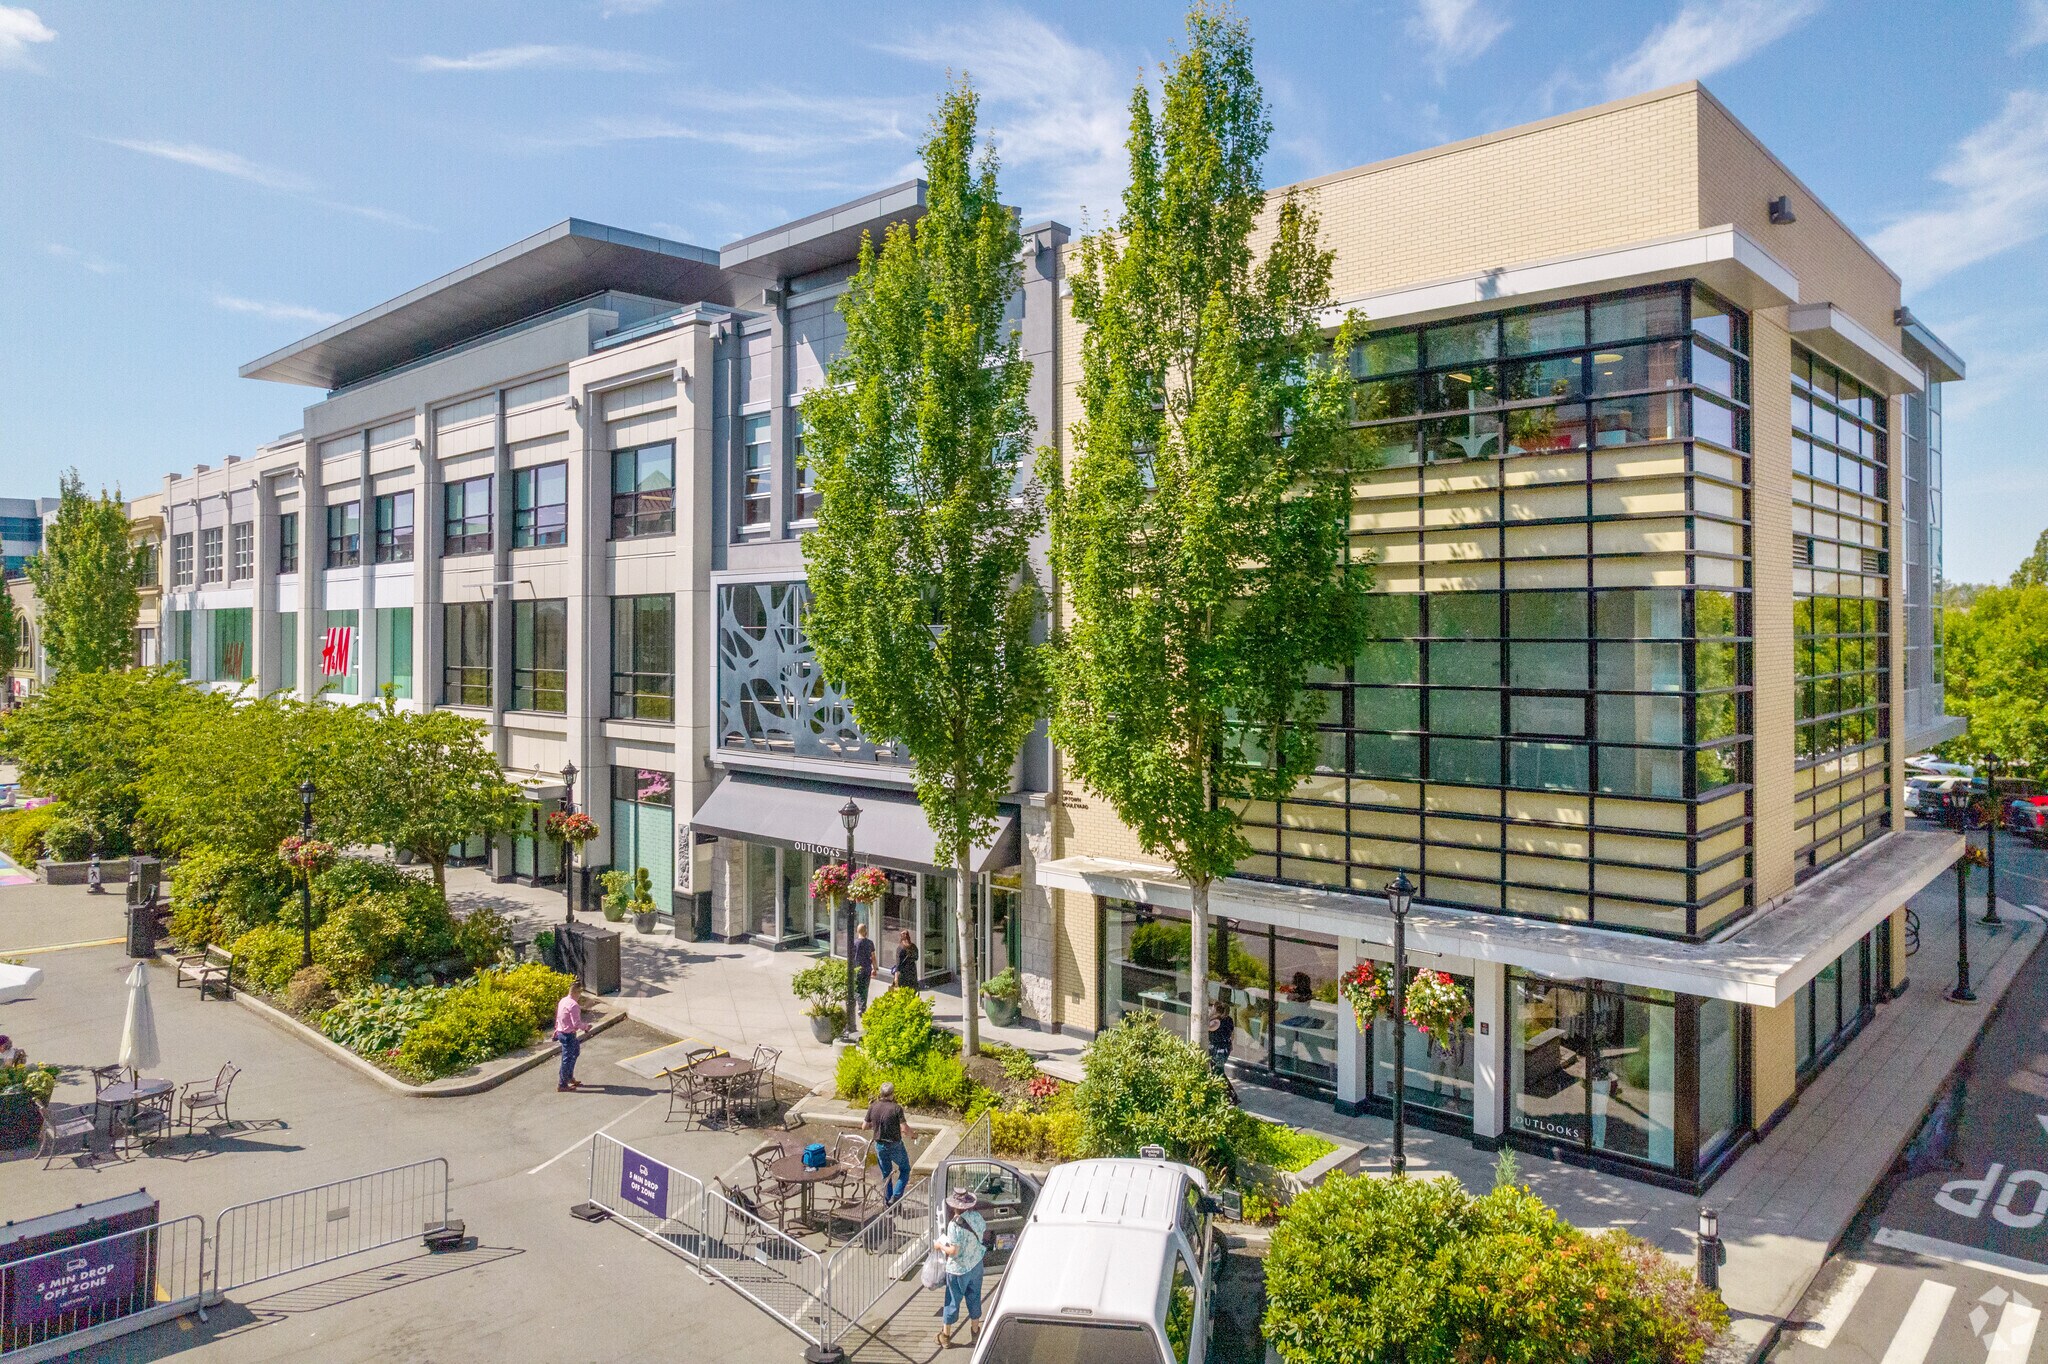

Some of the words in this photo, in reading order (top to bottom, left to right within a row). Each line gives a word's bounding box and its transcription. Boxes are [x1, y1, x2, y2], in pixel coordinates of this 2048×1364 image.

[321, 626, 351, 677] H&M
[1515, 1116, 1580, 1138] OUTLOOKS
[631, 1181, 641, 1192] OFF
[641, 1186, 656, 1199] ZONE
[633, 1173, 644, 1185] MIN
[644, 1179, 659, 1191] DROP
[37, 1282, 45, 1292] 5
[50, 1274, 76, 1289] MIN
[80, 1263, 115, 1280] DROP
[44, 1287, 68, 1301] OFF
[72, 1276, 107, 1293] ZONE
